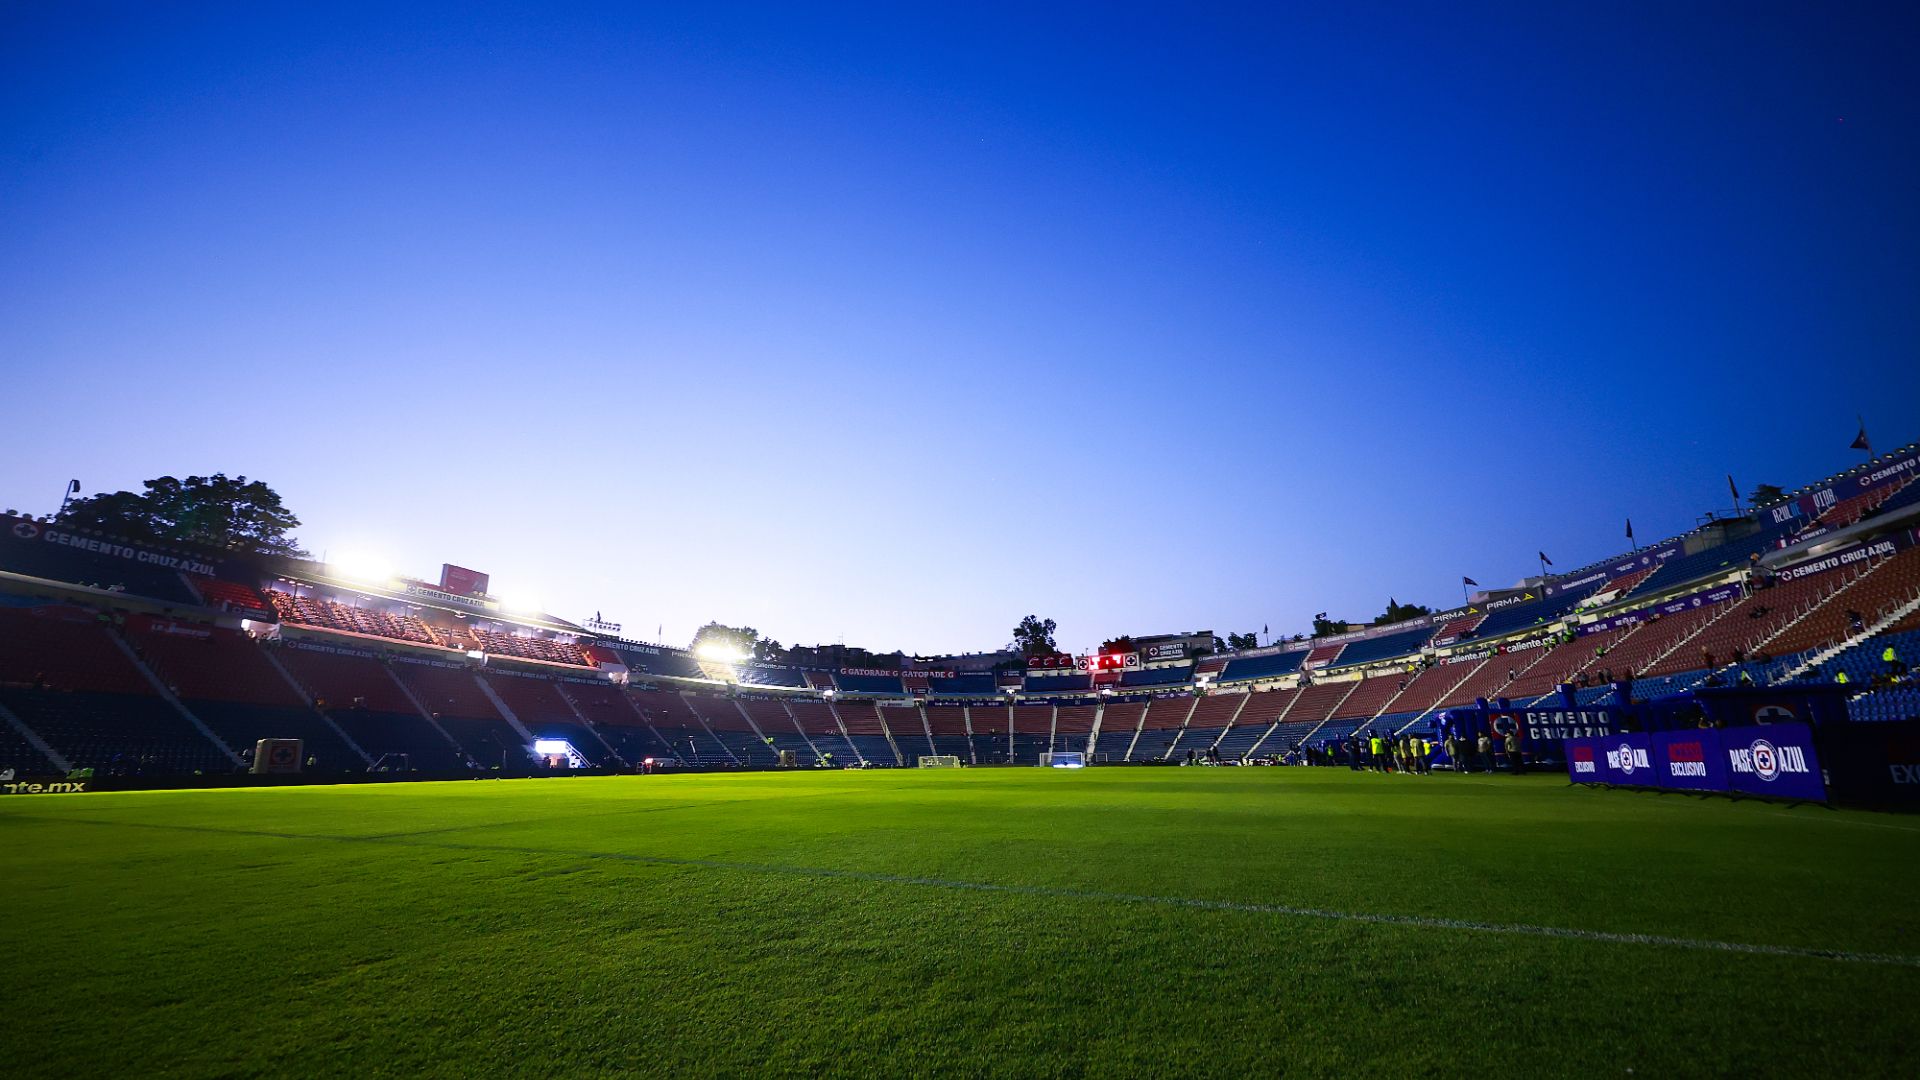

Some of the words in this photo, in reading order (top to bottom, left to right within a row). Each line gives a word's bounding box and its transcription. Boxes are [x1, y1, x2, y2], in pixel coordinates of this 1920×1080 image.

[1870, 458, 1916, 482] CEMENTO
[1772, 505, 1793, 524] AZUL
[44, 530, 134, 560] CEMENTO
[137, 551, 179, 569] CRUZ
[179, 561, 217, 577] AZUL
[1792, 556, 1840, 578] CEMENTO
[1840, 548, 1868, 564] CRUZ
[1868, 540, 1894, 557] AZUL
[417, 588, 452, 601] CEMENTO
[452, 596, 469, 604] CRUZ
[1486, 596, 1522, 610] PIRMA
[1432, 610, 1466, 623] PIRMA
[596, 640, 629, 651] CEMENTO
[1506, 636, 1553, 653] caliente.m
[848, 668, 891, 677] GATORADE
[1526, 711, 1609, 725] CEMENTO
[1530, 727, 1569, 740] CRUZ
[1633, 748, 1651, 768] AZUL
[1729, 748, 1754, 773] PASE
[1777, 746, 1809, 773] AZUL
[1670, 761, 1707, 777] EXCLUSIVO
